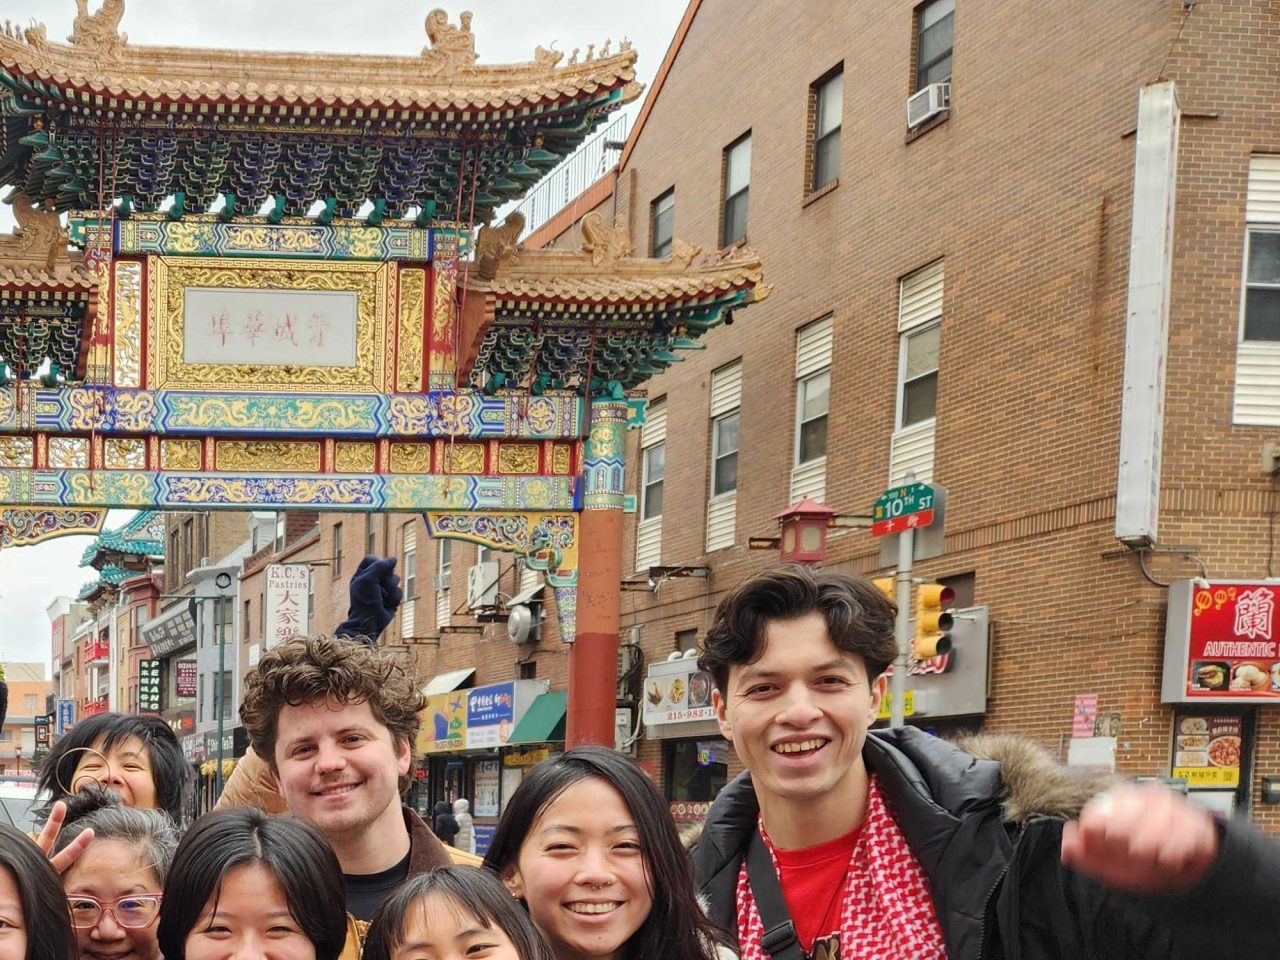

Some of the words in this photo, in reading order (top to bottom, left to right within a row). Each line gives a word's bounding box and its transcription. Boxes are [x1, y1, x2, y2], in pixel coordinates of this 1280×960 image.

[885, 495, 915, 518] 10TH
[918, 496, 932, 509] ST
[270, 567, 306, 579] K.C.'s
[268, 579, 308, 589] Pastries
[1203, 641, 1276, 657] AUTHENTIC
[150, 660, 160, 710] PENANG
